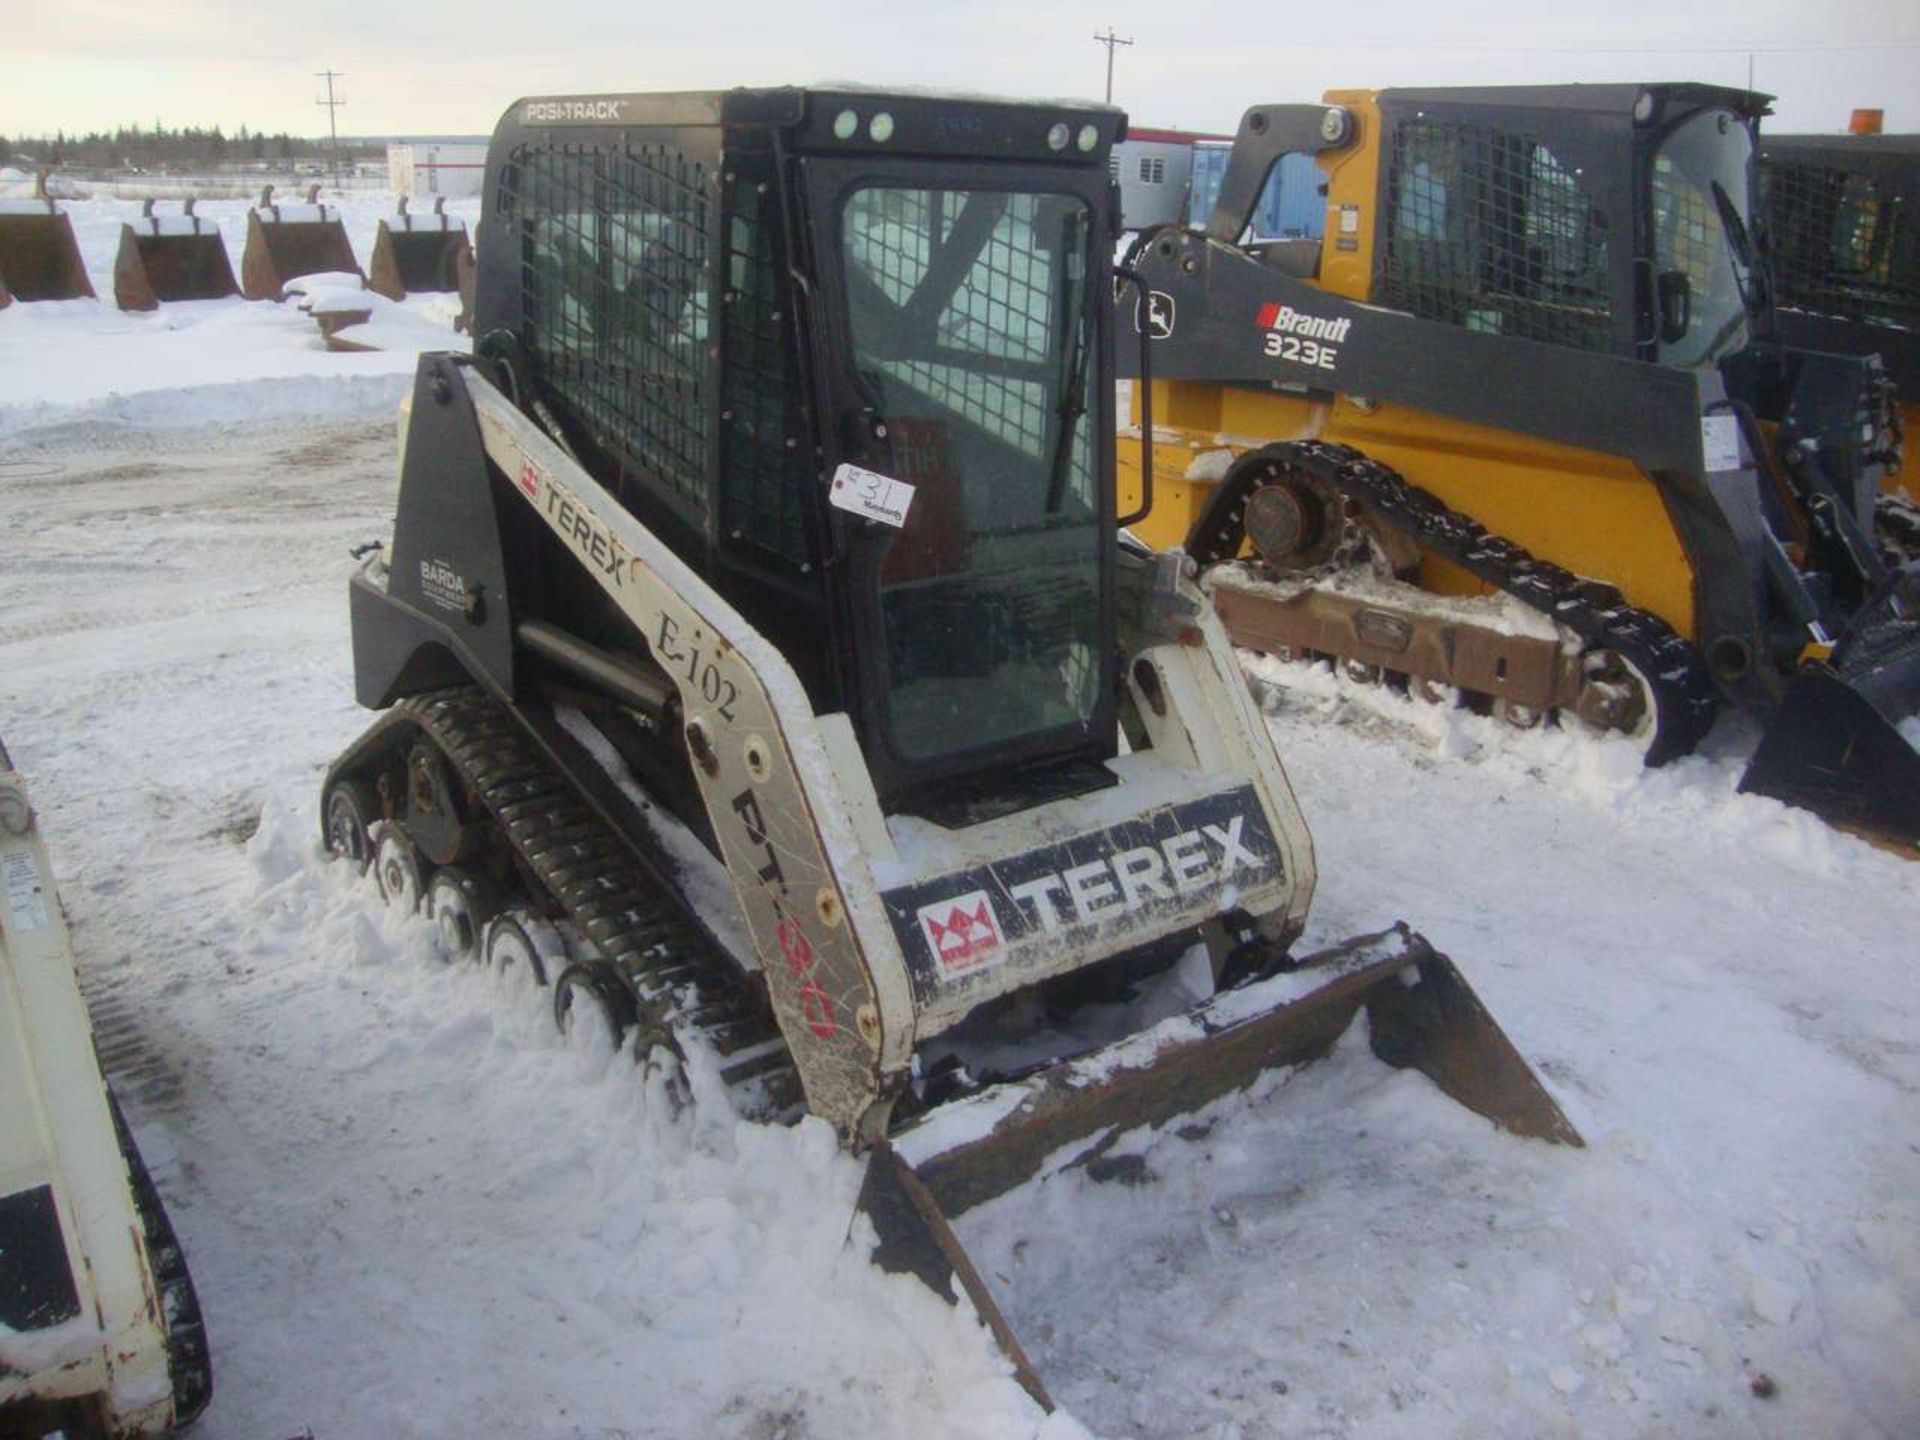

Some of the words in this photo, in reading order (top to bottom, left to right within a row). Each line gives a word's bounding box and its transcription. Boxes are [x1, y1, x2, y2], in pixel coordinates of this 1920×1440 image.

[527, 100, 620, 120] POSI-TRACK
[1273, 305, 1351, 343] Brandt
[1264, 332, 1337, 370] 323E
[545, 481, 625, 588] TEREX
[420, 560, 466, 595] BARDA
[656, 609, 737, 723] E-102
[1008, 815, 1263, 934] TEREX
